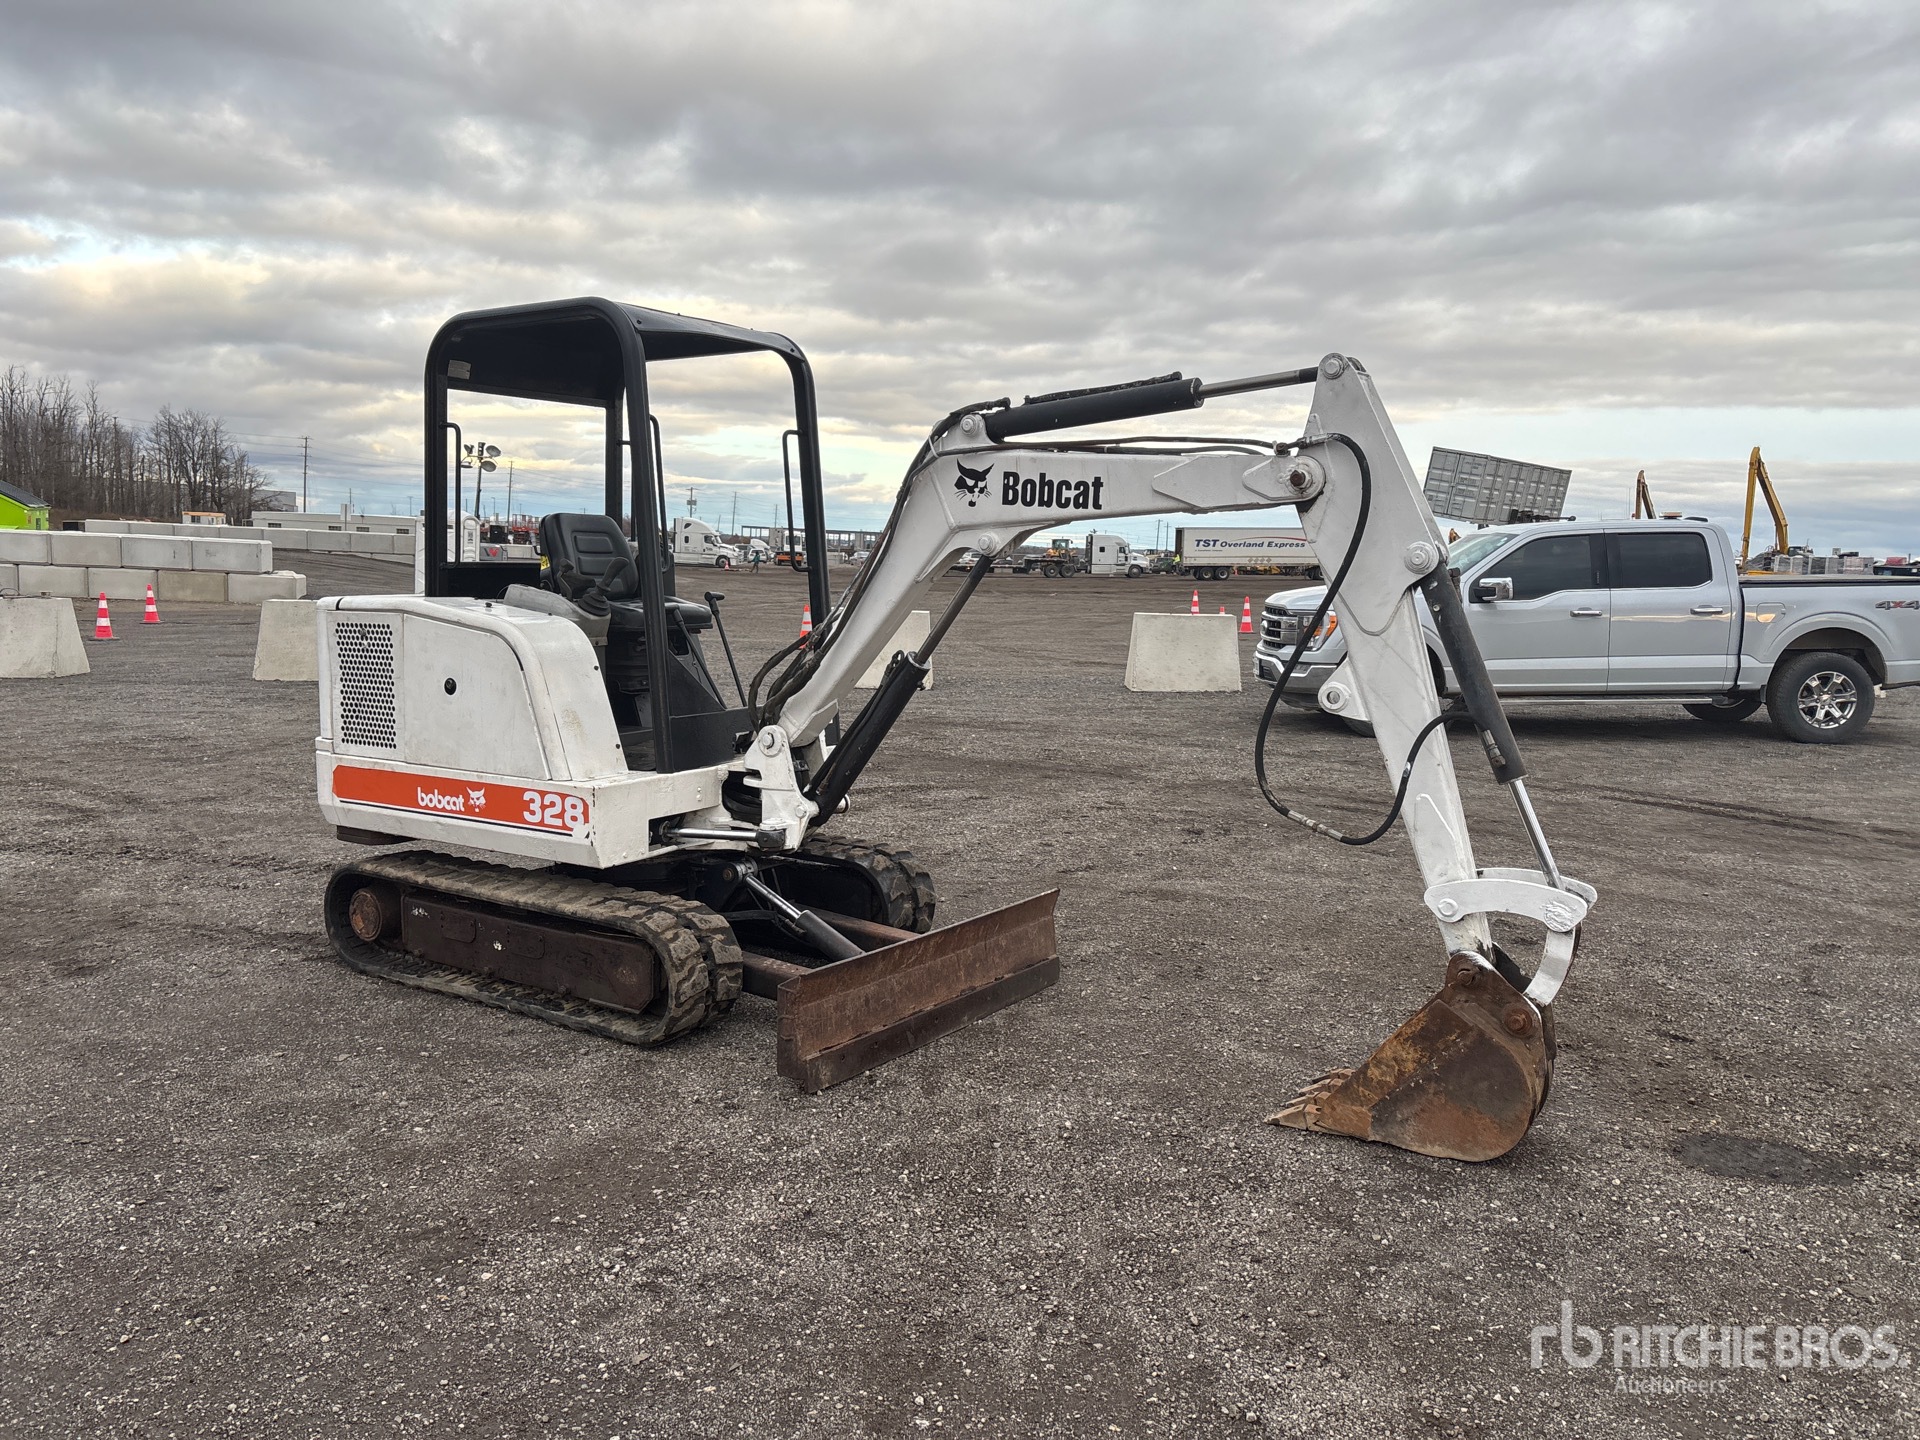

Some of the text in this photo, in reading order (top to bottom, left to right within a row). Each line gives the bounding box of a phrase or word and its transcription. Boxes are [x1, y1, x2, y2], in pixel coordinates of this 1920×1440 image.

[1002, 471, 1104, 510] Bobcat
[1195, 539, 1219, 548] TST
[1267, 541, 1306, 549] Express
[417, 786, 465, 812] bobcat
[522, 790, 586, 828] 328
